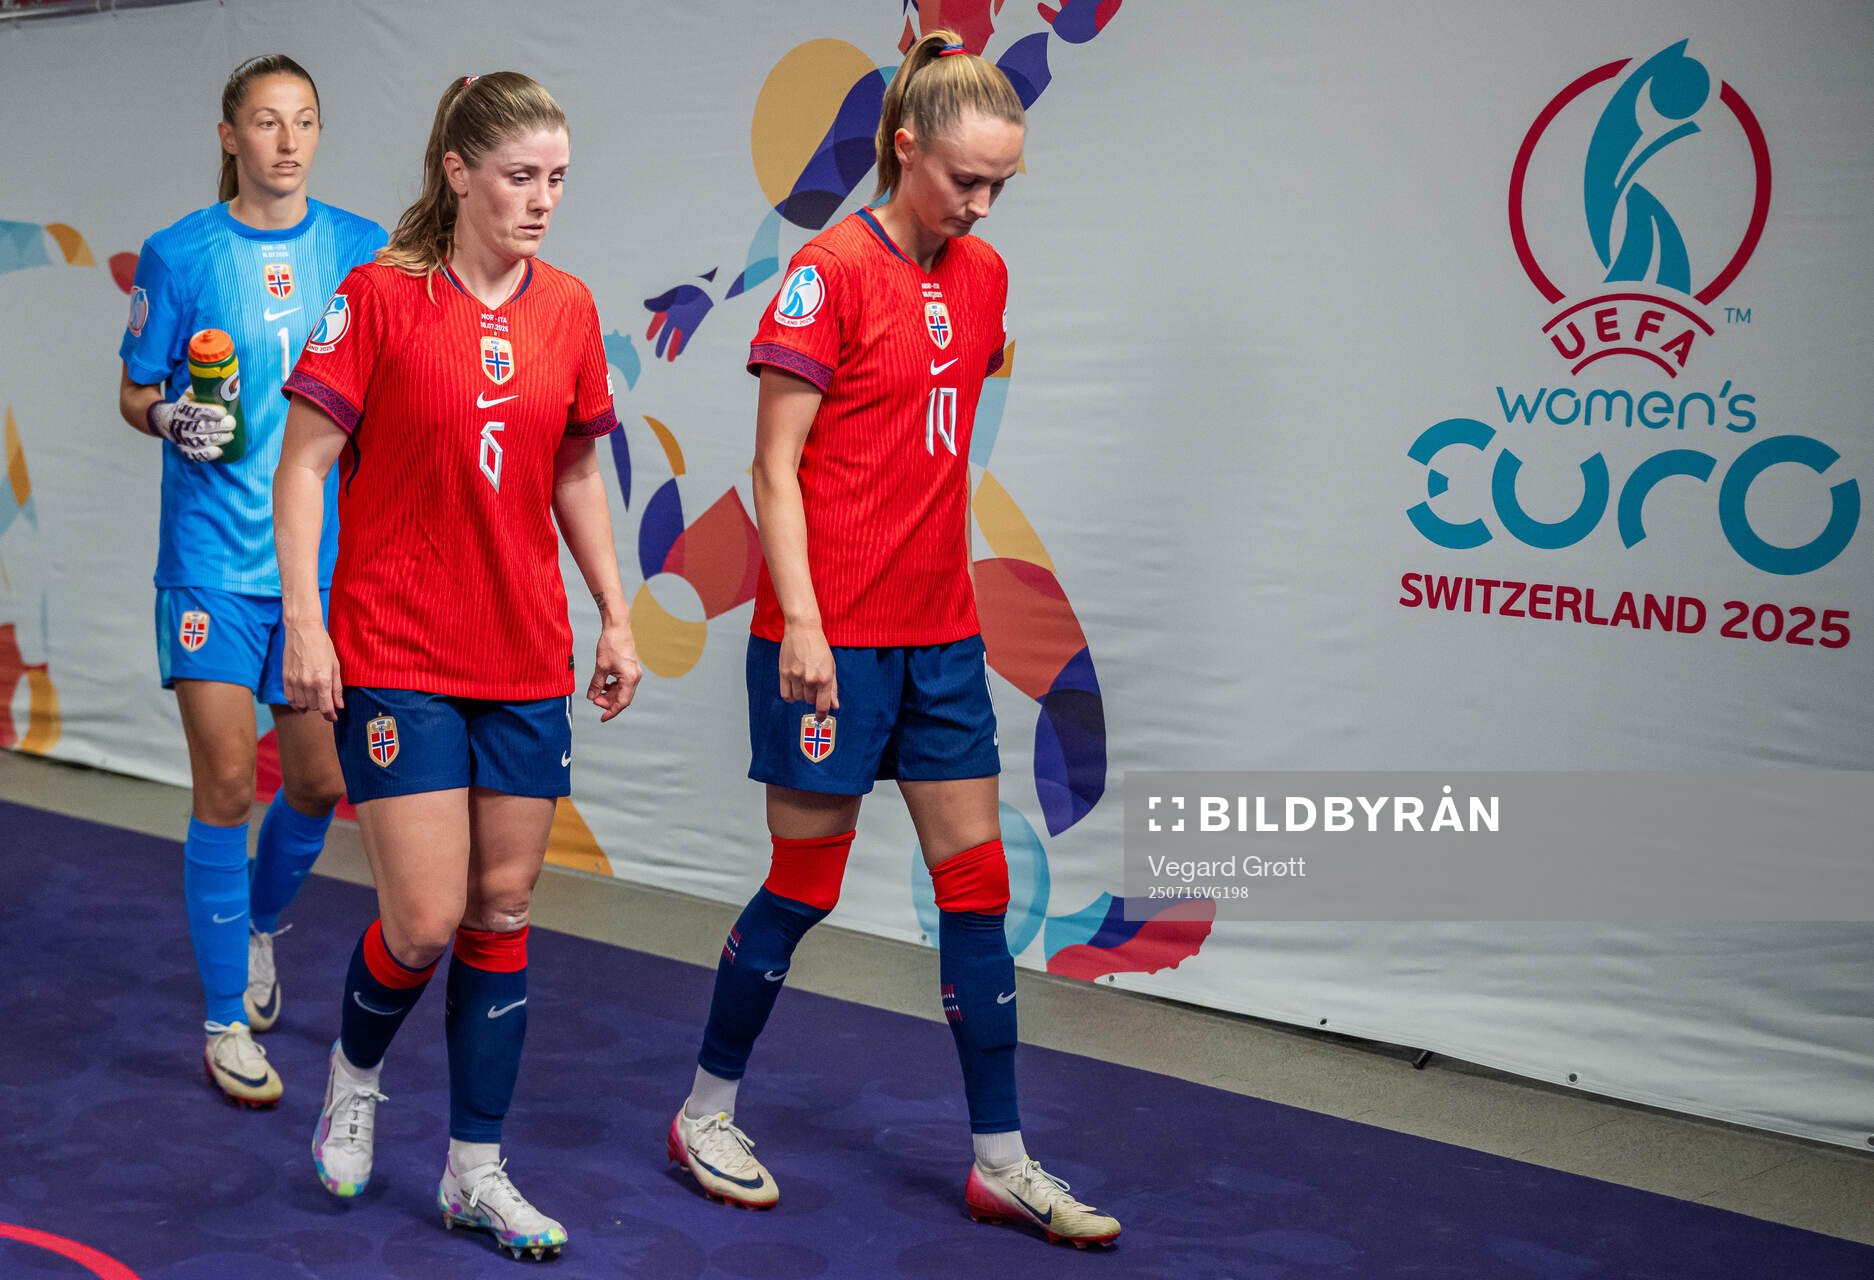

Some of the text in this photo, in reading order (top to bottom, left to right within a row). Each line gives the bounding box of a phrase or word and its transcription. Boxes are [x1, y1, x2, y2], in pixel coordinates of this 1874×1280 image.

[1552, 308, 1696, 367] UEFA
[1725, 307, 1752, 322] TM
[277, 327, 291, 382] 1
[925, 387, 958, 457] 10
[1496, 379, 1757, 434] women's
[479, 421, 506, 493] 6
[1398, 571, 1851, 649] SWITZERLAND 2025
